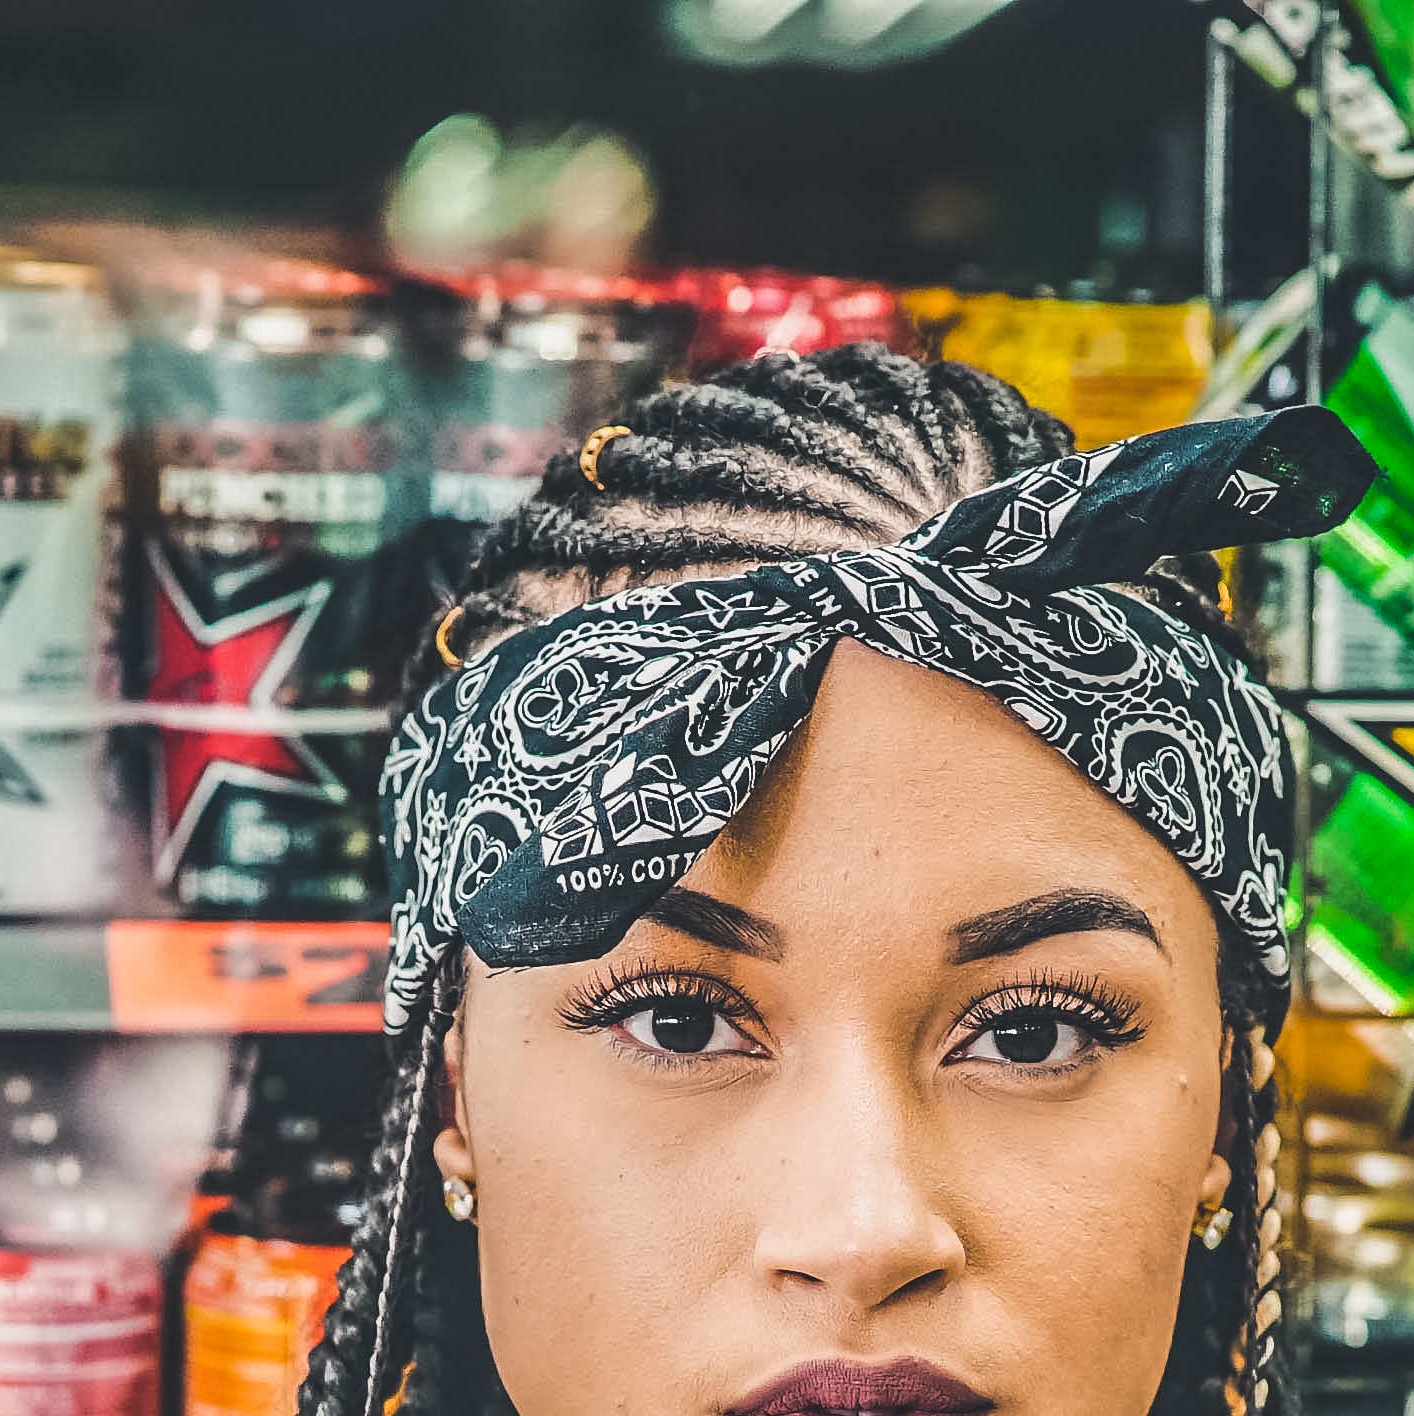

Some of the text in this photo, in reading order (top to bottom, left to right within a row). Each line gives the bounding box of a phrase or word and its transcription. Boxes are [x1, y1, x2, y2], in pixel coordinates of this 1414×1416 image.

[779, 560, 843, 617] DE IN
[555, 850, 699, 894] 100% COTT
